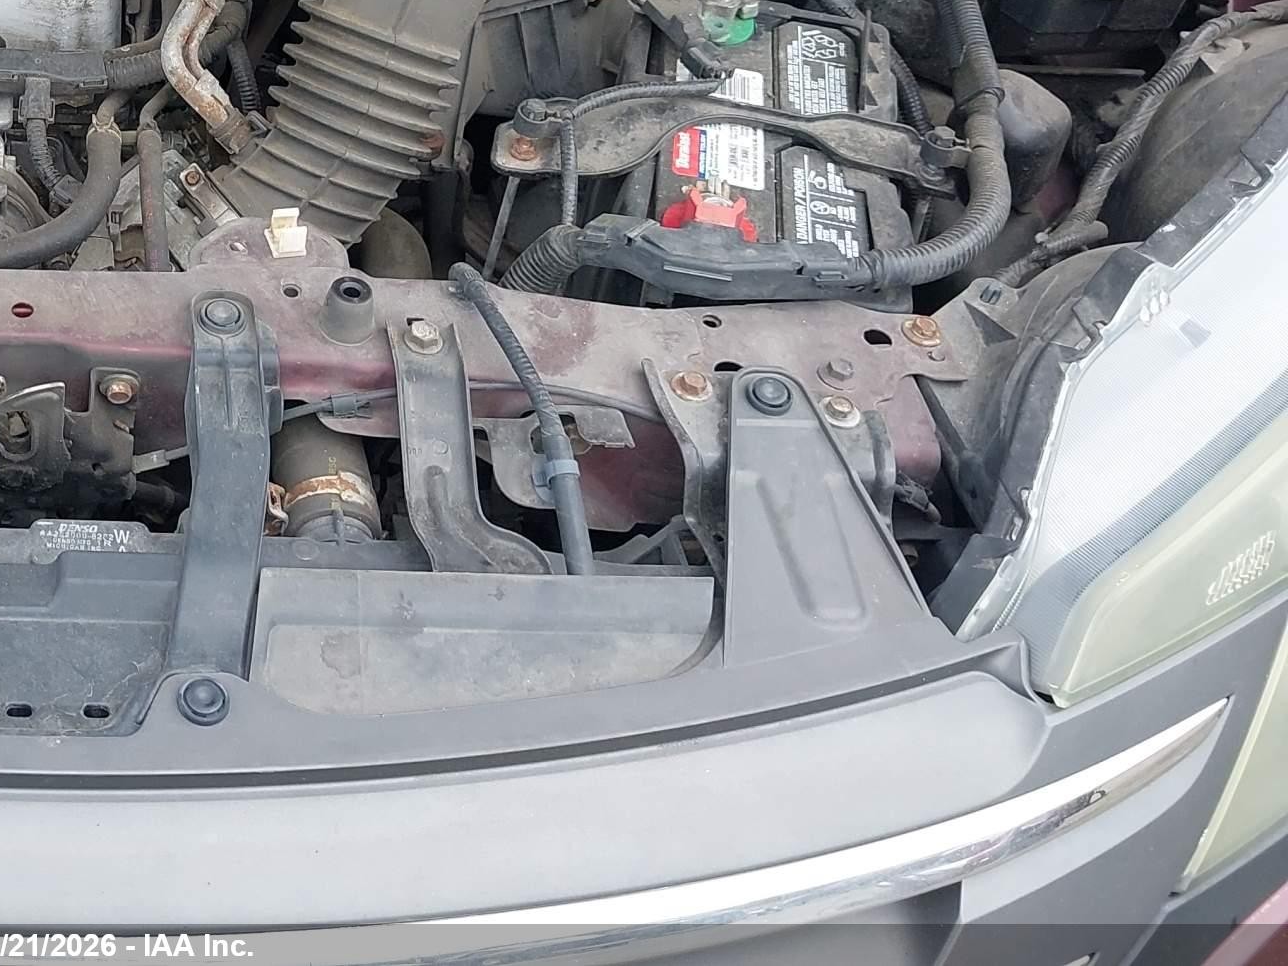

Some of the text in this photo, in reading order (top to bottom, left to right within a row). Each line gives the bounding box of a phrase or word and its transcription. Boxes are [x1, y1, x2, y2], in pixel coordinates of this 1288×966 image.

[793, 167, 807, 198] POISON
[795, 205, 809, 239] DANGER
[59, 524, 98, 533] DENSO
